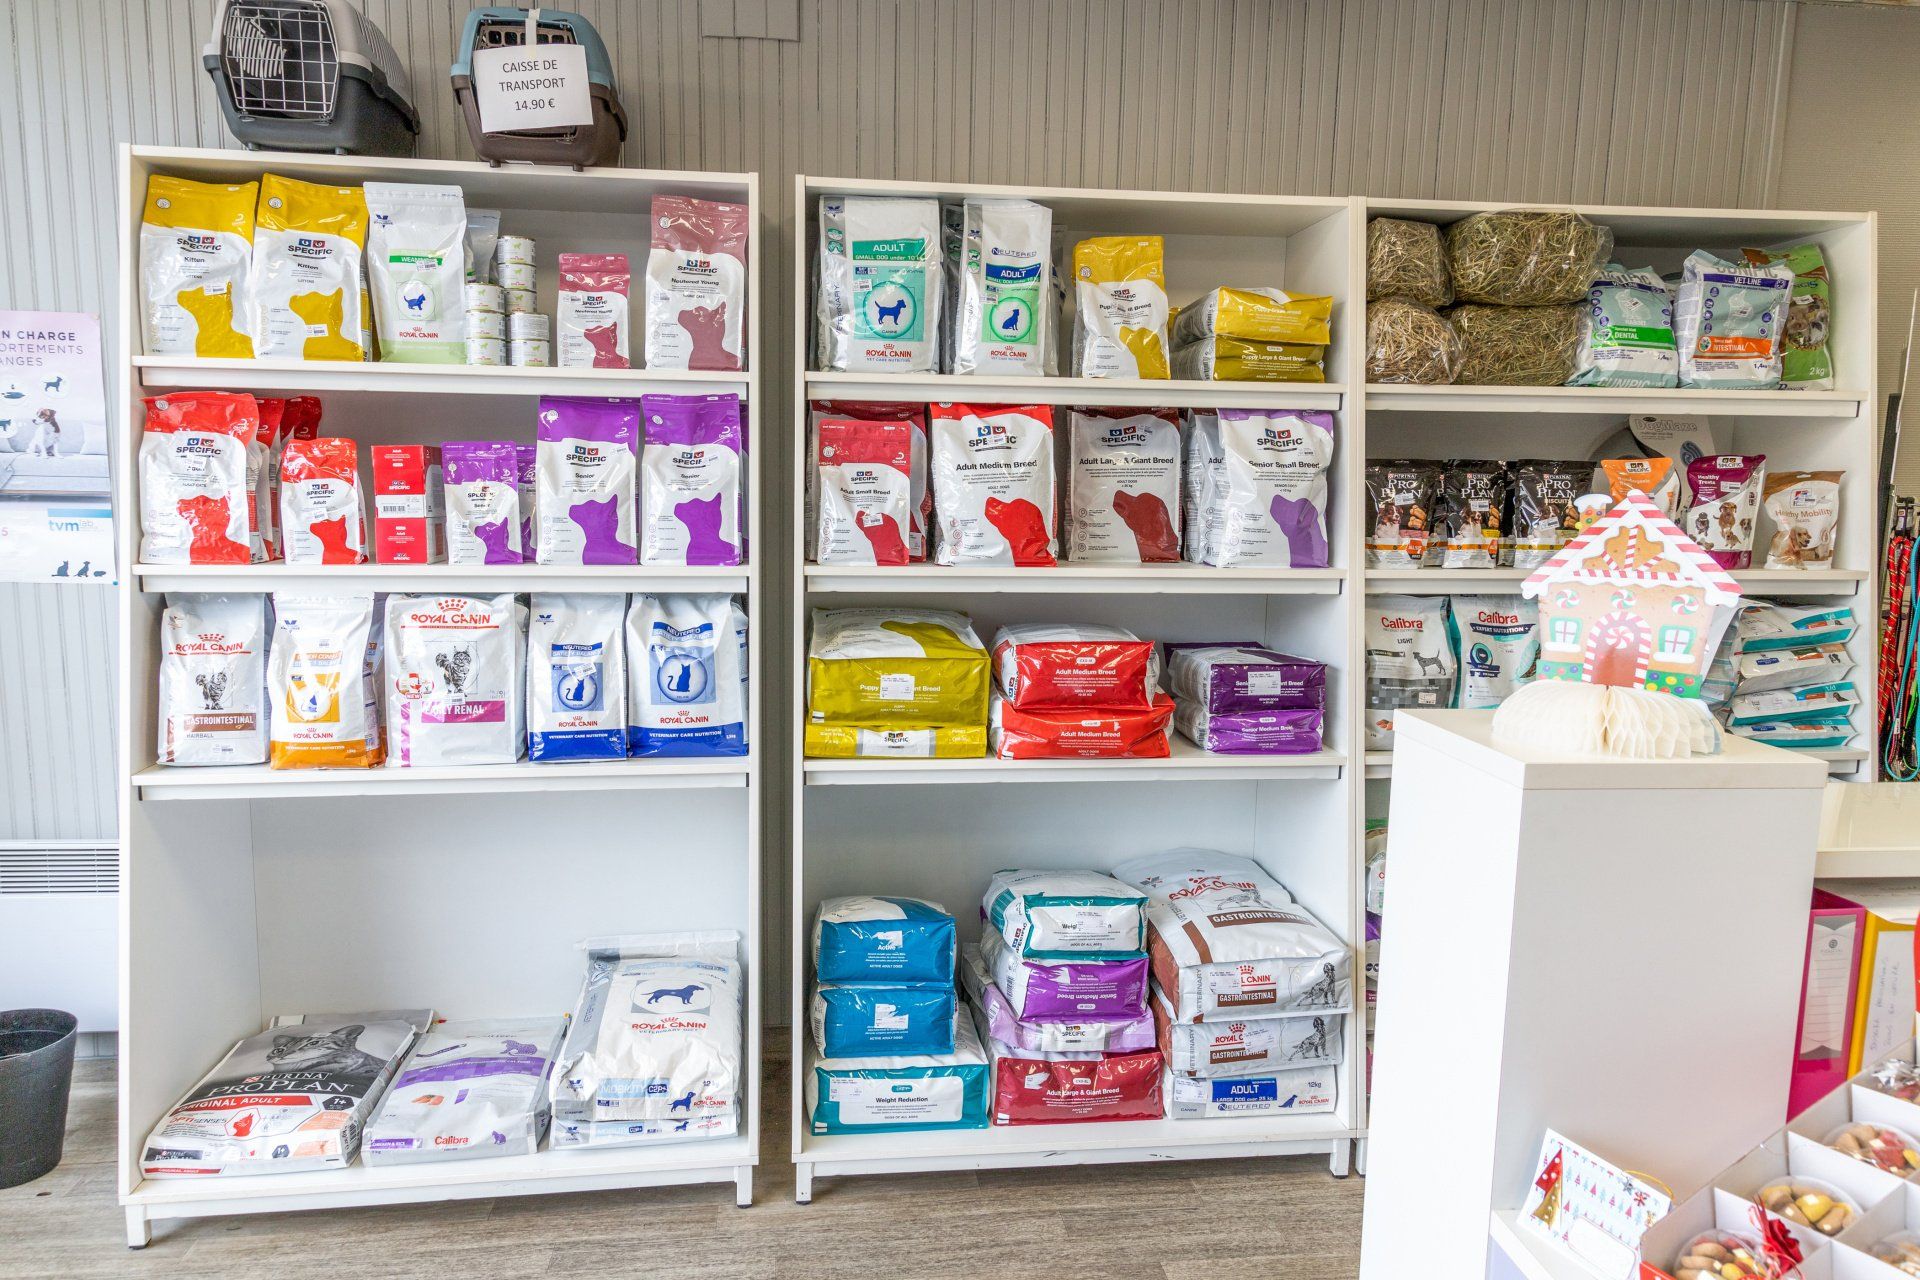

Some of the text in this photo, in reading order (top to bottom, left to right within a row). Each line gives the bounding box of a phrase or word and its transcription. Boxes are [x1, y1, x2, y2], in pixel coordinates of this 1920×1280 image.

[502, 59, 558, 74] CAISSE DE
[499, 78, 565, 92] TRANSPORT
[514, 98, 555, 111] 14.90 €
[176, 238, 222, 251] SPECIFIC
[288, 244, 333, 255] SPECIFIC
[873, 244, 905, 252] ADULT
[992, 247, 1037, 257] NEUTERED
[677, 266, 718, 274] SPECIFIC
[17, 331, 75, 341] CHARGE
[1635, 419, 1697, 432] DogMaze
[969, 435, 1017, 447] SPEIC
[1101, 434, 1146, 443] SPECIFIC
[1257, 438, 1304, 448] SPECIFIC
[176, 446, 221, 455] SPECIFIC
[566, 454, 606, 462] SPECIFIC
[1014, 460, 1037, 468] Breed
[1388, 479, 1415, 489] PRO
[1467, 479, 1491, 489] PRO
[1544, 479, 1571, 489] PRO
[1461, 488, 1494, 498] PLAN
[1537, 488, 1576, 498] PLAN
[1800, 508, 1834, 518] Mobility
[48, 520, 79, 531] tvm
[411, 613, 490, 625] ROYAL CANIN
[1381, 616, 1423, 629] Calibra
[1478, 611, 1519, 624] Calibra
[667, 626, 700, 637] NEUTERED
[176, 642, 243, 652] ROYAL CANIN
[454, 705, 485, 714] RENAL
[186, 716, 254, 726] GASTROINTESTINAL
[1168, 880, 1256, 901] ROYAL CANIN
[1219, 992, 1274, 1002] GASTROINTESTINAL
[632, 1020, 706, 1030] ROYAL CANIN
[1215, 1035, 1237, 1043] ROYAL
[262, 1072, 328, 1081] PURINA
[209, 1079, 350, 1096] PRO PLAN
[648, 1085, 668, 1093] C2P+
[1230, 1084, 1260, 1094] ADULT
[180, 1098, 236, 1111] ORIGINAL
[875, 1096, 897, 1104] Weight
[435, 1136, 468, 1145] Calibra
